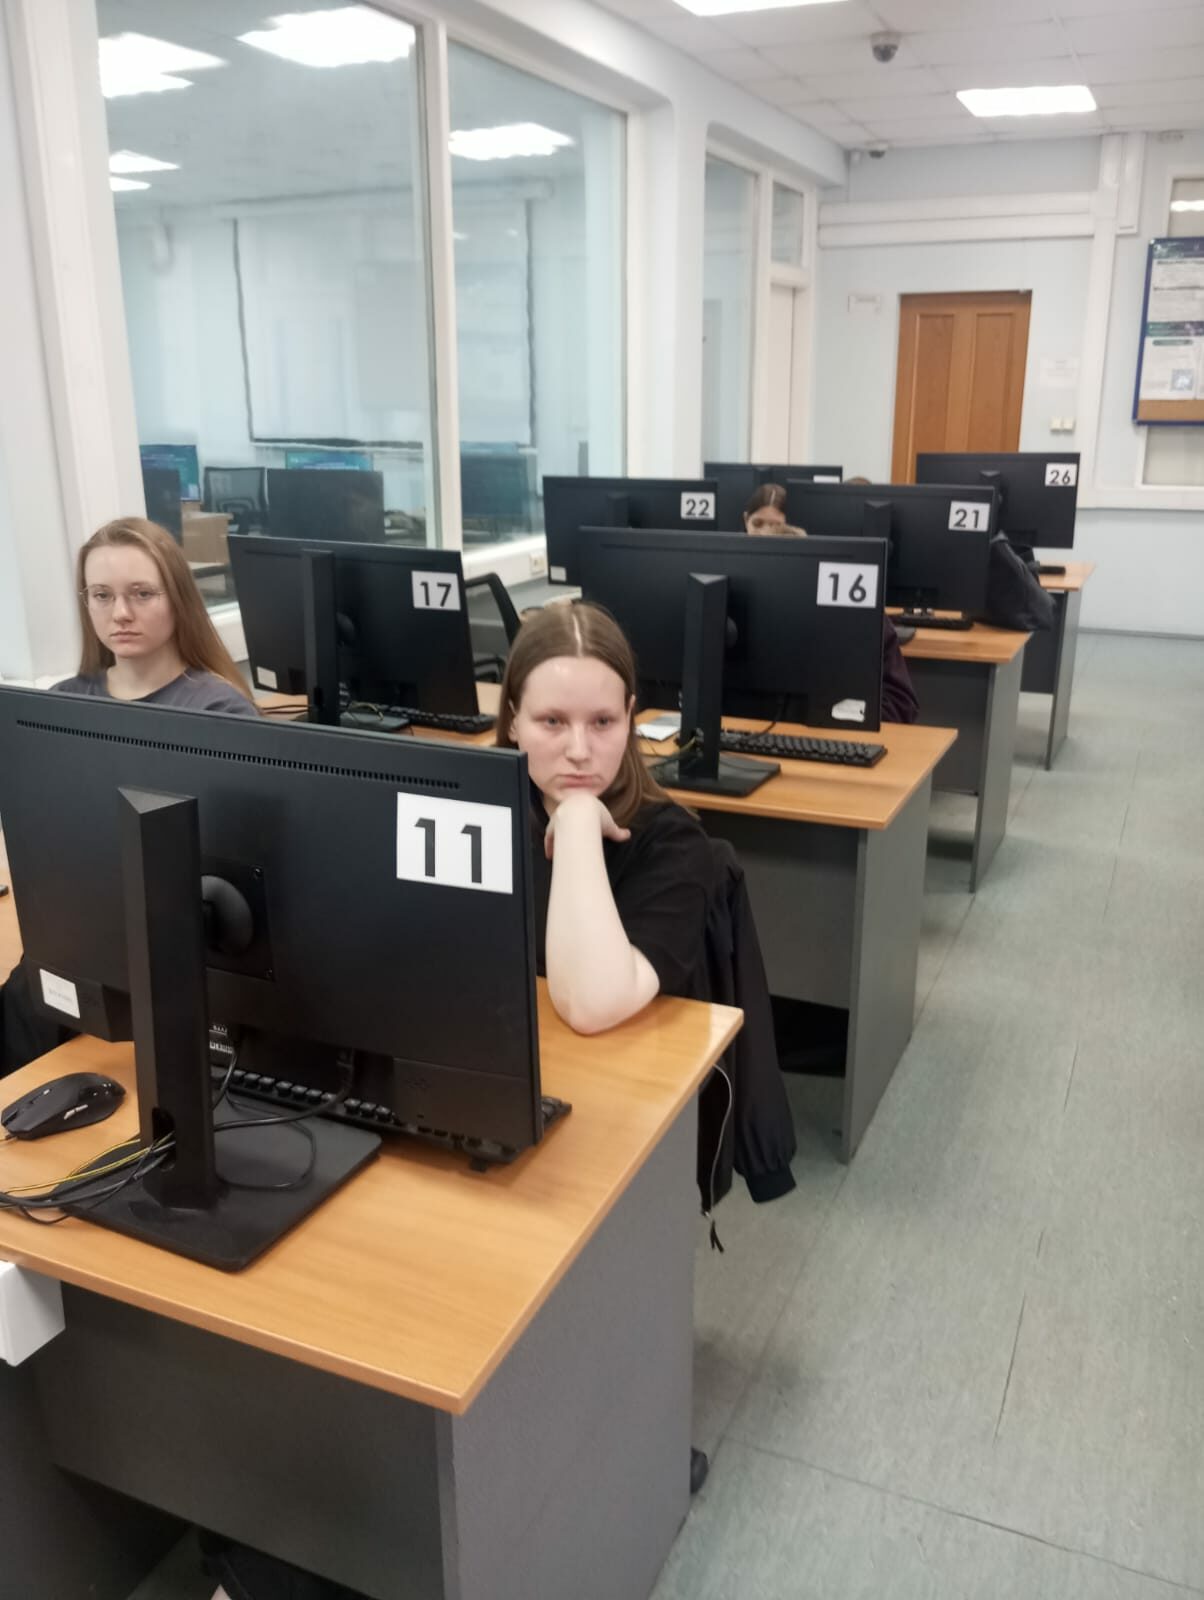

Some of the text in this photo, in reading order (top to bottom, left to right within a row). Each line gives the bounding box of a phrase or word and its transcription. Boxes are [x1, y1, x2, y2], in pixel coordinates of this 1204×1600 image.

[1050, 469, 1072, 485] 26
[685, 498, 710, 516] 22
[954, 508, 981, 529] 21
[420, 581, 452, 607] 17
[829, 573, 867, 603] 16
[413, 816, 483, 885] 11
